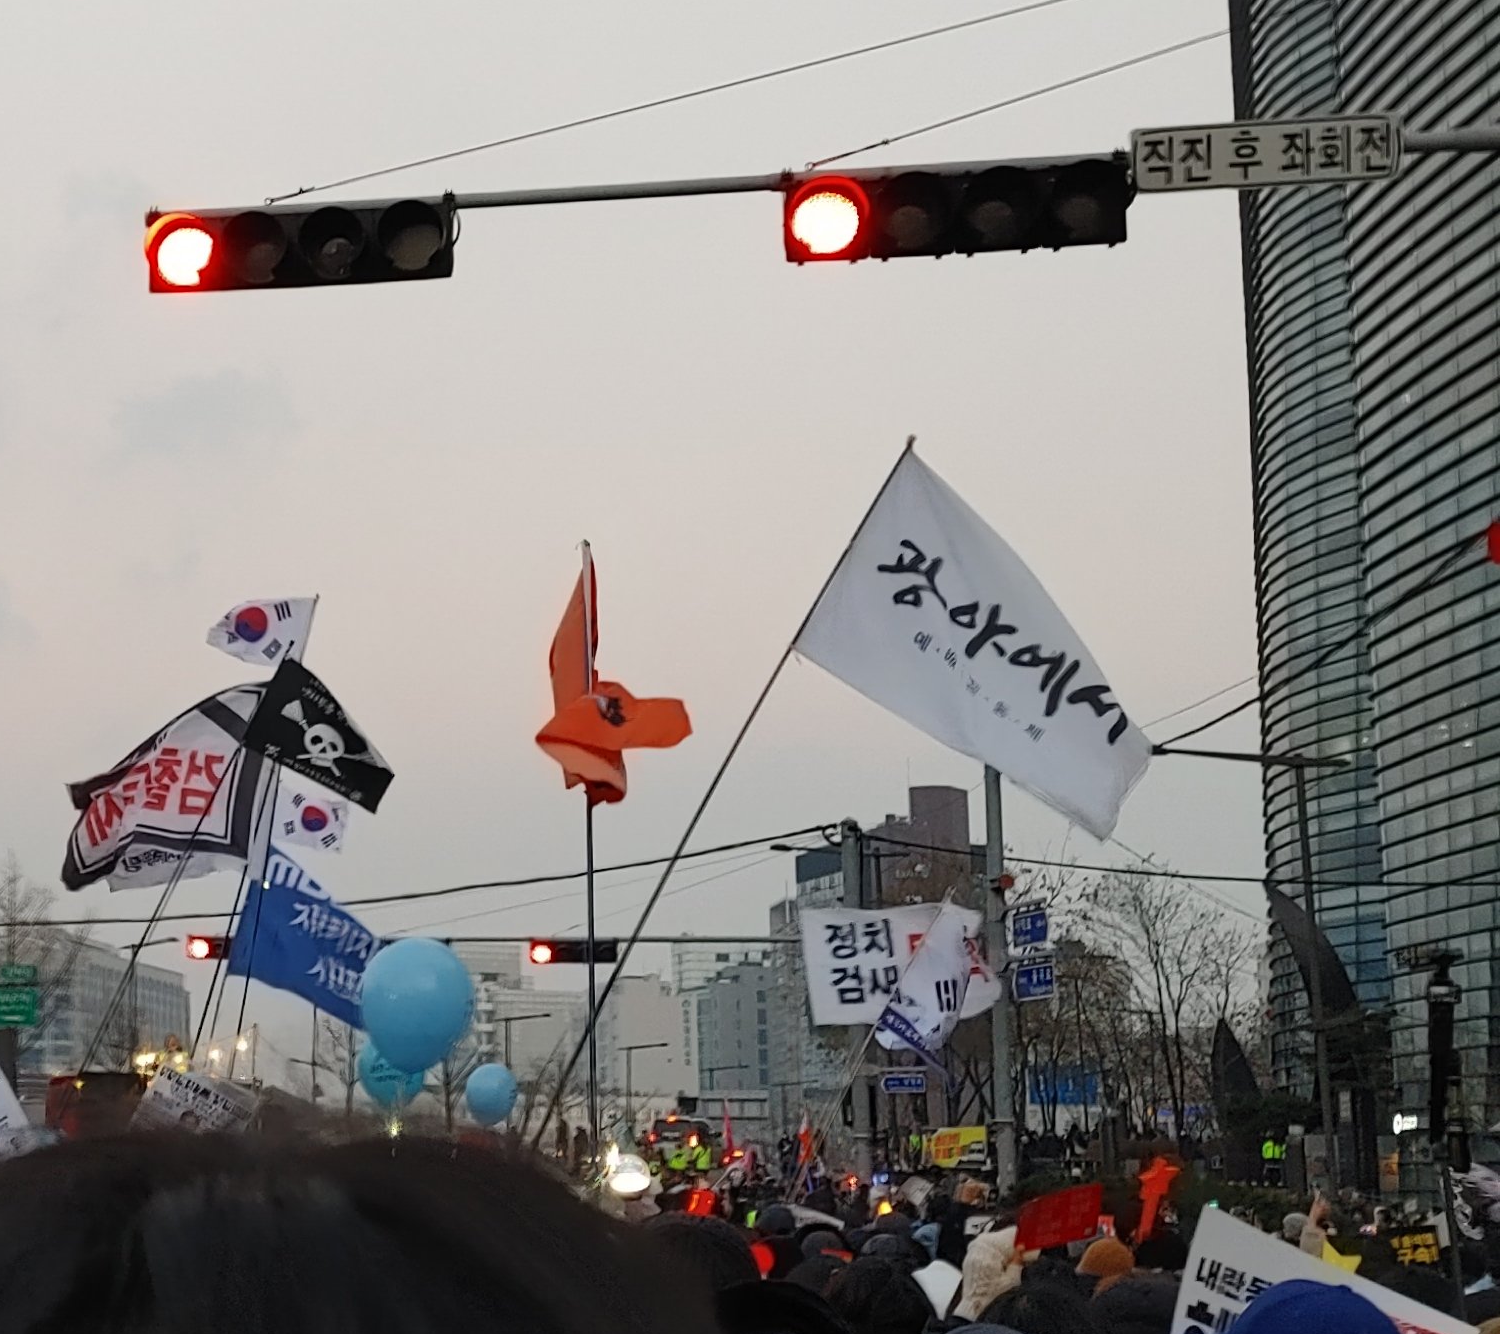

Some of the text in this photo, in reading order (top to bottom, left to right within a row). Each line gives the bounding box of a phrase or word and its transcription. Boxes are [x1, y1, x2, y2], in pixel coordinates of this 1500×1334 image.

[1141, 121, 1391, 184] 직진 후 좌회전
[876, 539, 1130, 746] 광야에서
[825, 918, 895, 959] 정치
